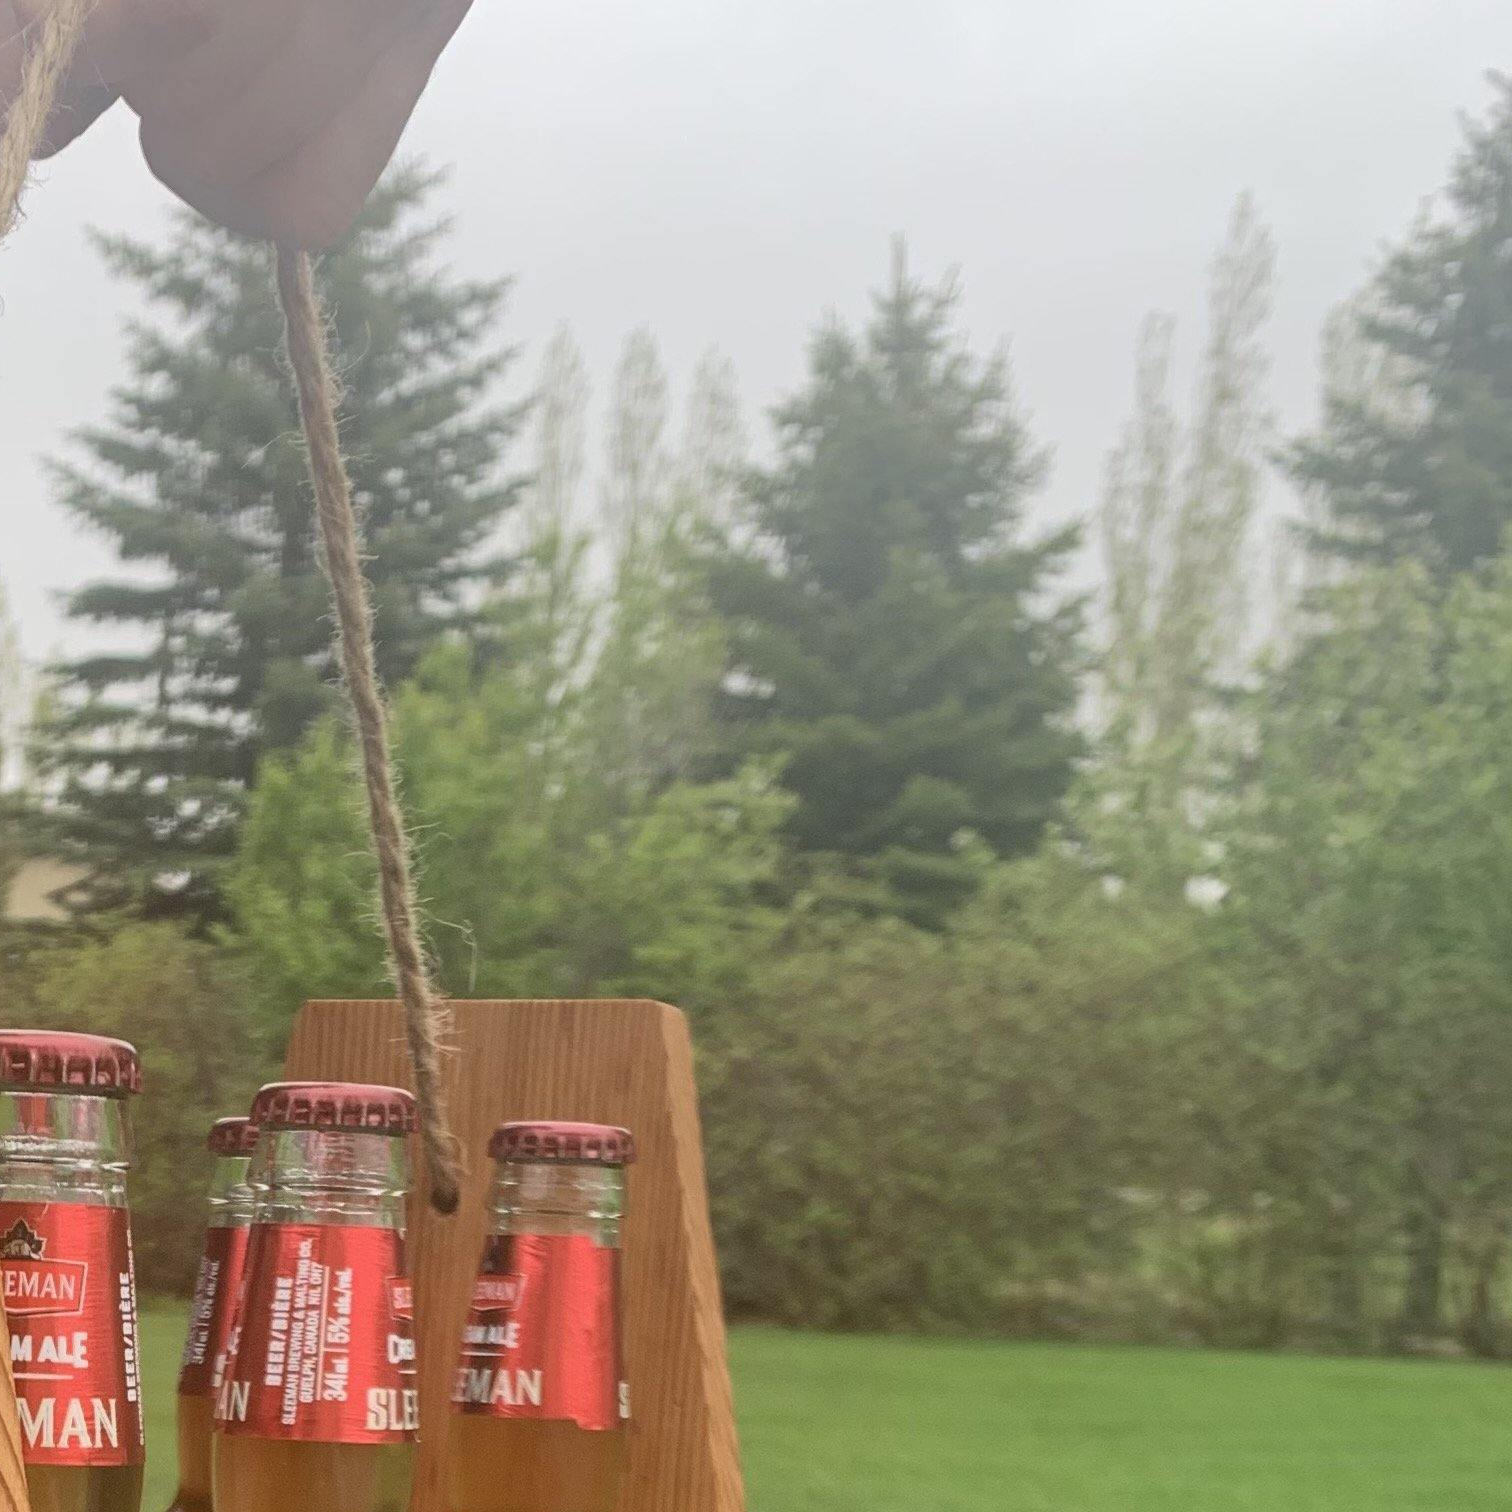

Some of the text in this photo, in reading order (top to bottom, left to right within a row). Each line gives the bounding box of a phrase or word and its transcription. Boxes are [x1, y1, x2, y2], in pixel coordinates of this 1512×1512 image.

[1, 1271, 75, 1300] EMAN
[294, 1260, 311, 1308] MALTING
[37, 1331, 88, 1368] ALE
[264, 1276, 293, 1387] BEER/BIÈRE
[287, 1321, 305, 1373] BREWING
[304, 1310, 320, 1355] CANADA
[326, 1316, 350, 1344] 5%
[17, 1397, 119, 1449] MAN
[281, 1374, 298, 1426] SLEEMAN
